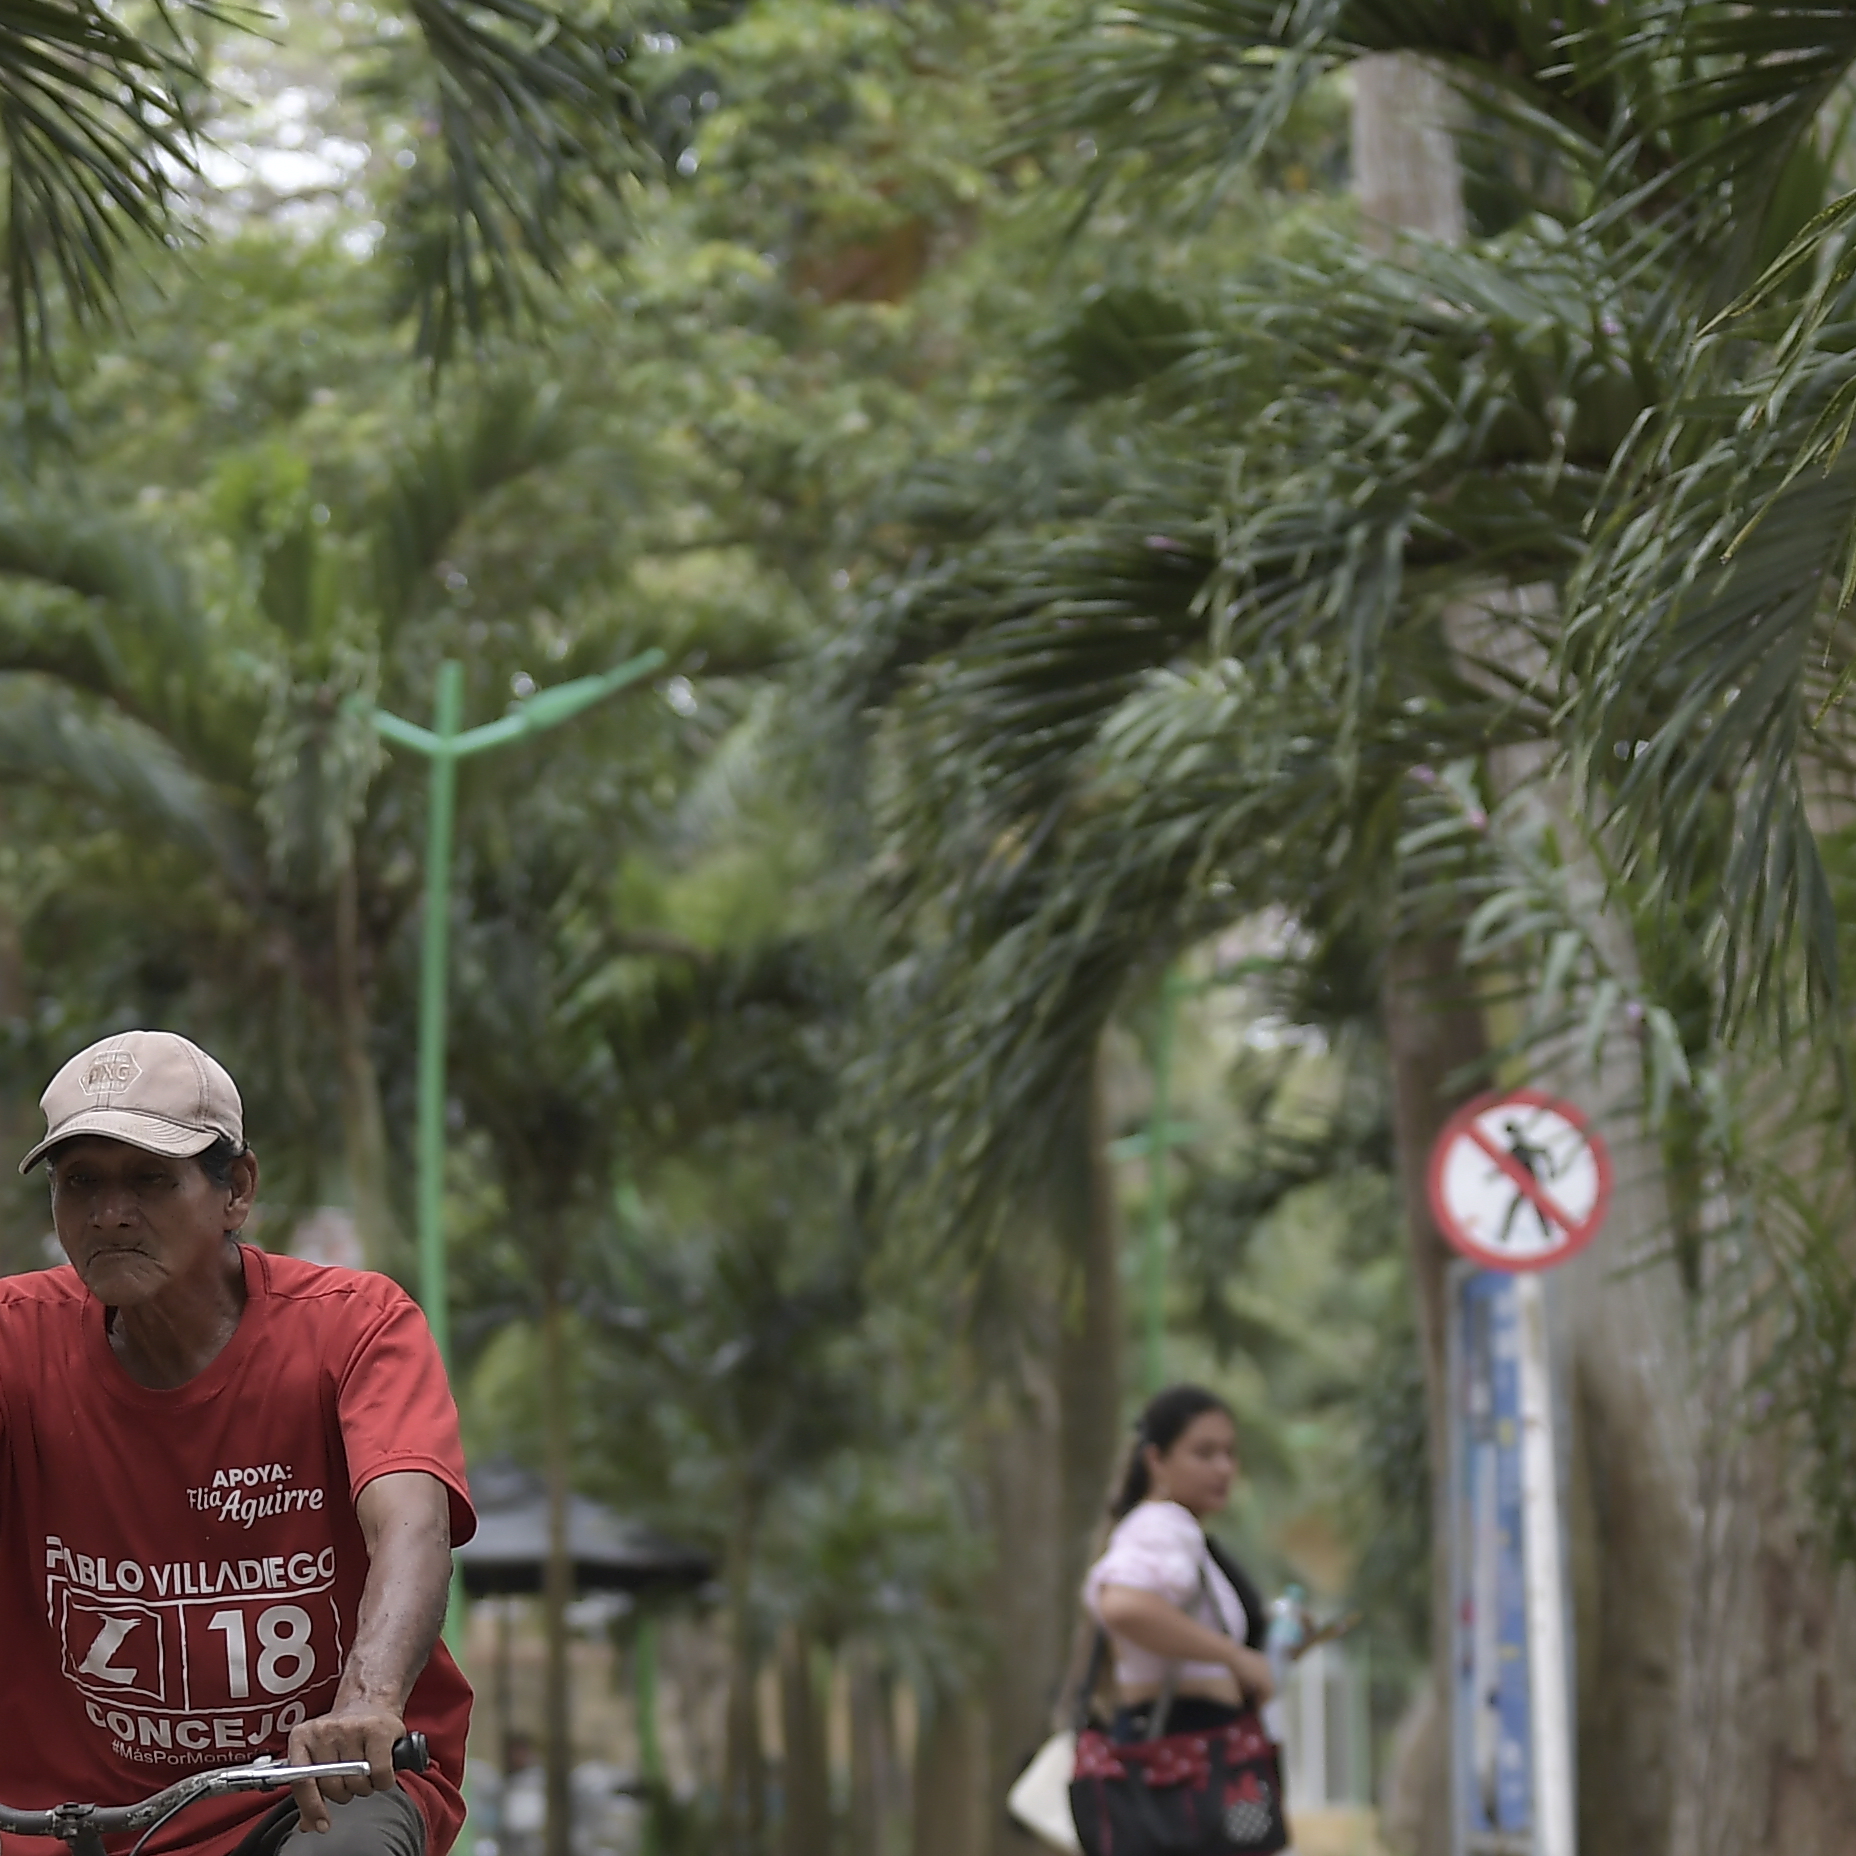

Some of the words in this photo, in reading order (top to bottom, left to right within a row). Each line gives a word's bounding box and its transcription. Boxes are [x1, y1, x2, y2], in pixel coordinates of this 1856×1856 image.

[211, 1462, 293, 1489] APOYA:
[186, 1486, 223, 1511] Flia
[217, 1483, 324, 1530] Aguirre
[148, 1546, 336, 1597] VILLADIEGO
[206, 1604, 316, 1699] 18
[85, 1700, 306, 1750] CONCEJO
